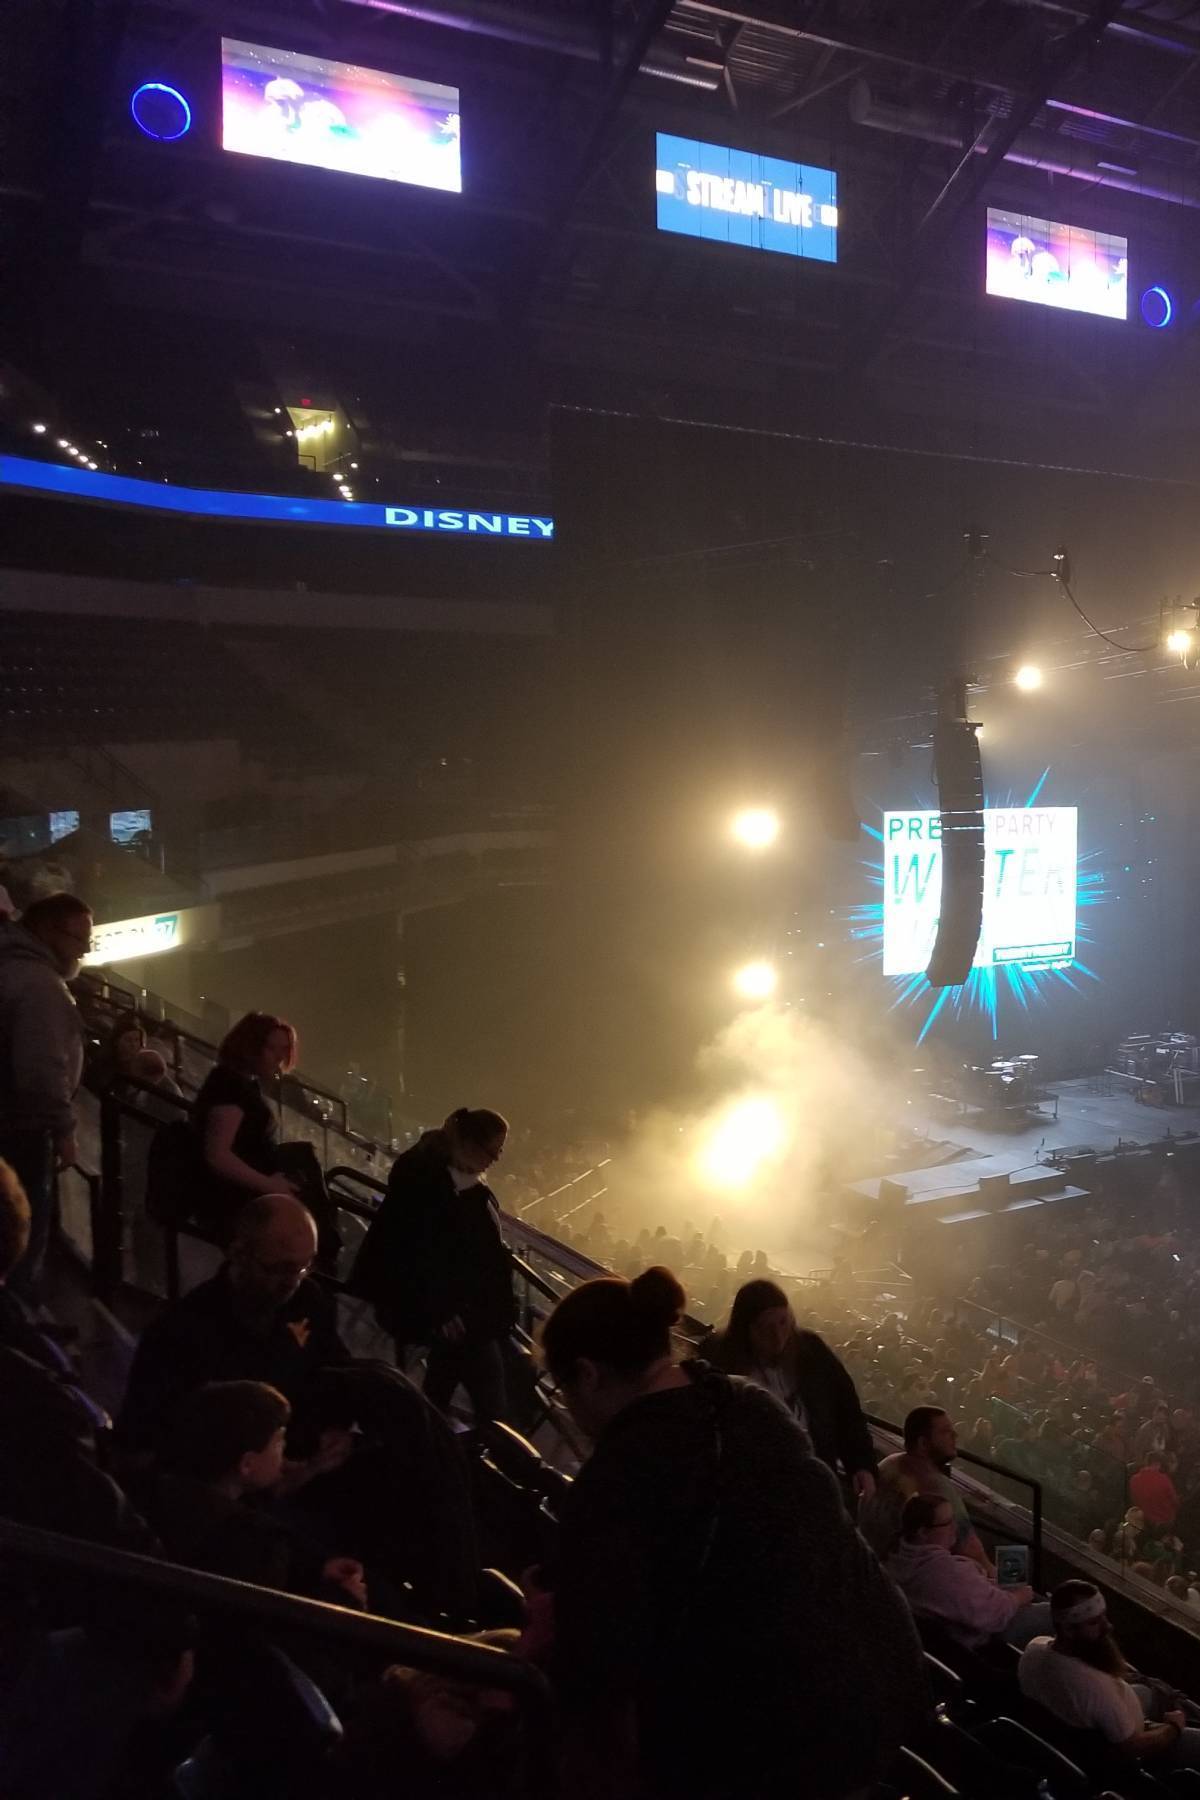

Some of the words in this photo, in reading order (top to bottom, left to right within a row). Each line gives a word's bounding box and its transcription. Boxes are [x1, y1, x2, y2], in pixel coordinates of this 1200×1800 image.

[686, 170, 764, 217] STREAM
[773, 188, 813, 228] LIVE
[385, 507, 554, 536] DISNEY
[995, 813, 1056, 836] PARTY
